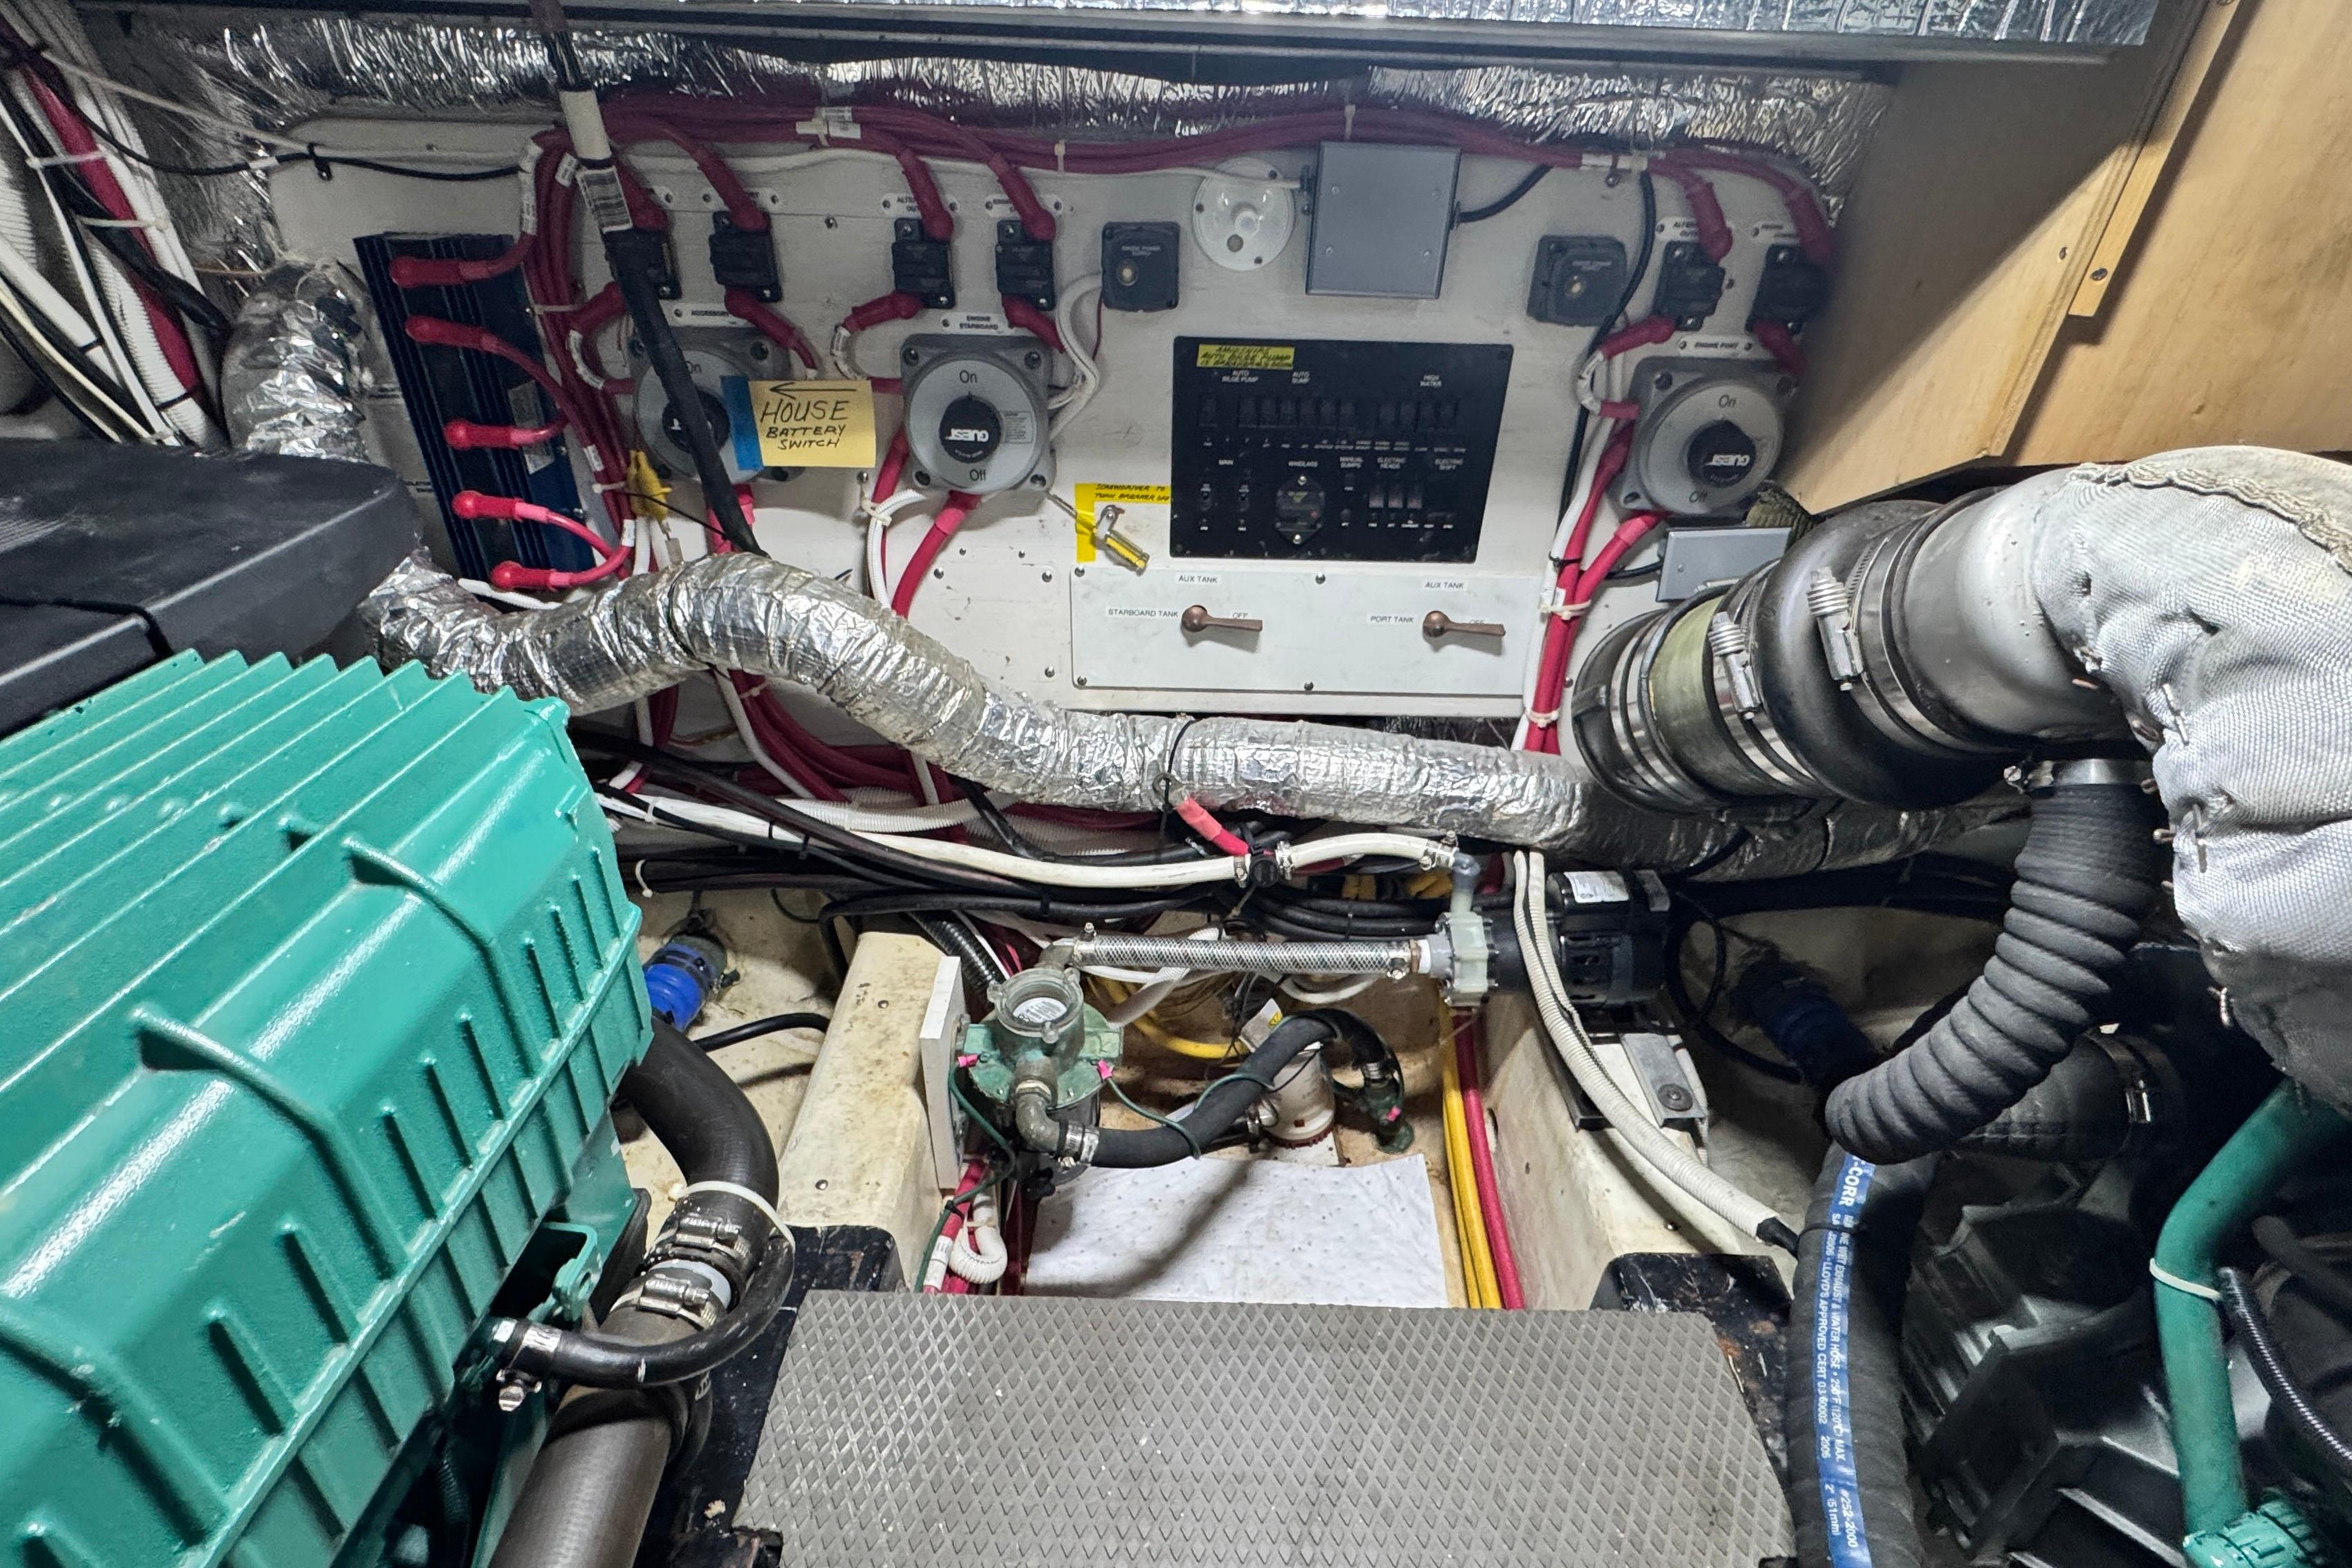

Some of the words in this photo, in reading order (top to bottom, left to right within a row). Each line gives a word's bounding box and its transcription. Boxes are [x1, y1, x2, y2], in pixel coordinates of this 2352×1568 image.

[959, 369, 978, 384] On
[1718, 394, 1737, 409] On
[760, 398, 850, 424] HOUSE
[766, 423, 846, 438] BATTERY
[945, 427, 989, 443] GUEST
[777, 438, 840, 451] SWITCH
[1704, 454, 1751, 467] GUEST
[969, 469, 987, 482] Off
[1688, 491, 1708, 503] Off
[1178, 575, 1195, 583] AUX
[1196, 575, 1218, 584] TANK
[1108, 608, 1157, 617] STARBOARD
[1159, 610, 1179, 618] TANK
[1394, 615, 1415, 624] TANK
[1837, 1246, 1849, 1265] WET
[1831, 1264, 1845, 1303] EXHAUST
[1817, 1298, 1828, 1350] APPROVED
[1830, 1311, 1842, 1342] WATER
[1830, 1343, 1841, 1370] HOSE
[1817, 1353, 1827, 1379] CERT
[1826, 1497, 1841, 1536] (51mm)
[1839, 1488, 1858, 1548] #252-2000
